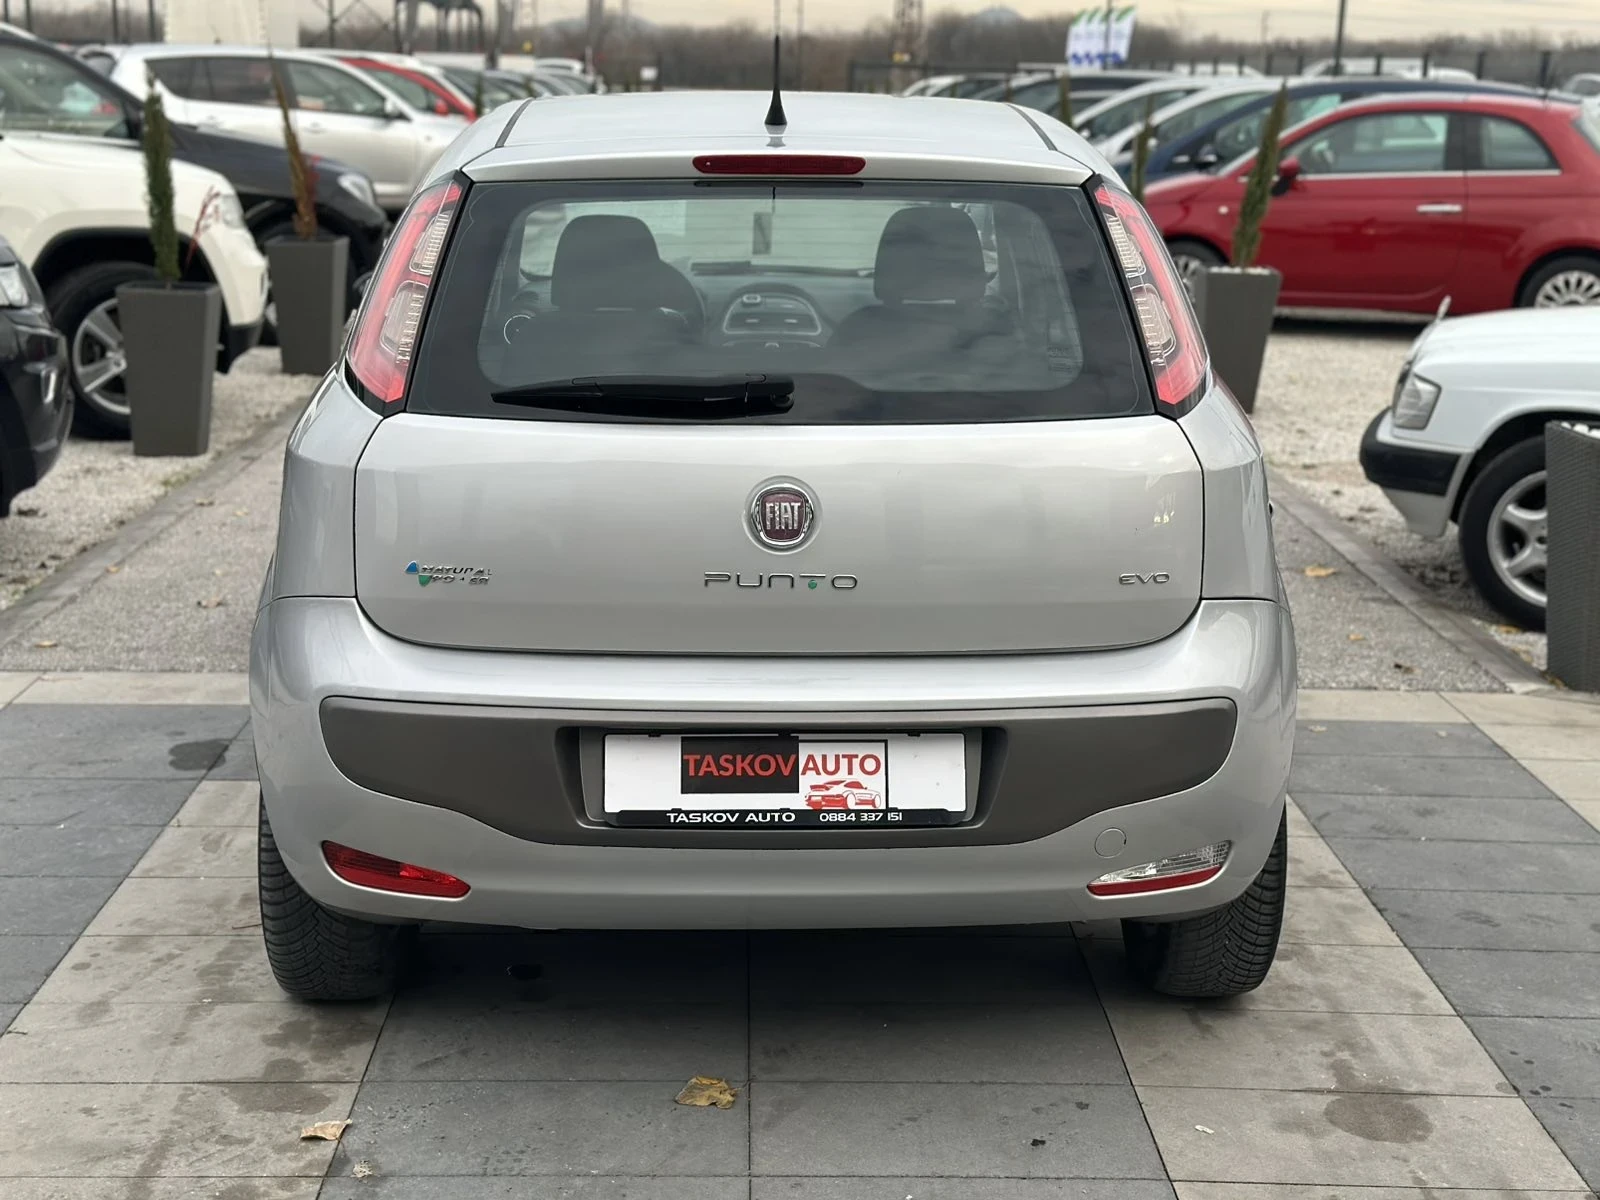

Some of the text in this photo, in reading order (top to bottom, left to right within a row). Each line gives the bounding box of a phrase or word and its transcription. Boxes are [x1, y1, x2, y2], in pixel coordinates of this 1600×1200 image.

[765, 502, 801, 530] FIAT
[431, 574, 489, 586] POER
[704, 571, 858, 590] PUNTO
[1119, 572, 1170, 585] EVO
[683, 753, 882, 777] TASKOV AUTO
[666, 811, 903, 823] TASKOV AUTO 0884 337 151
